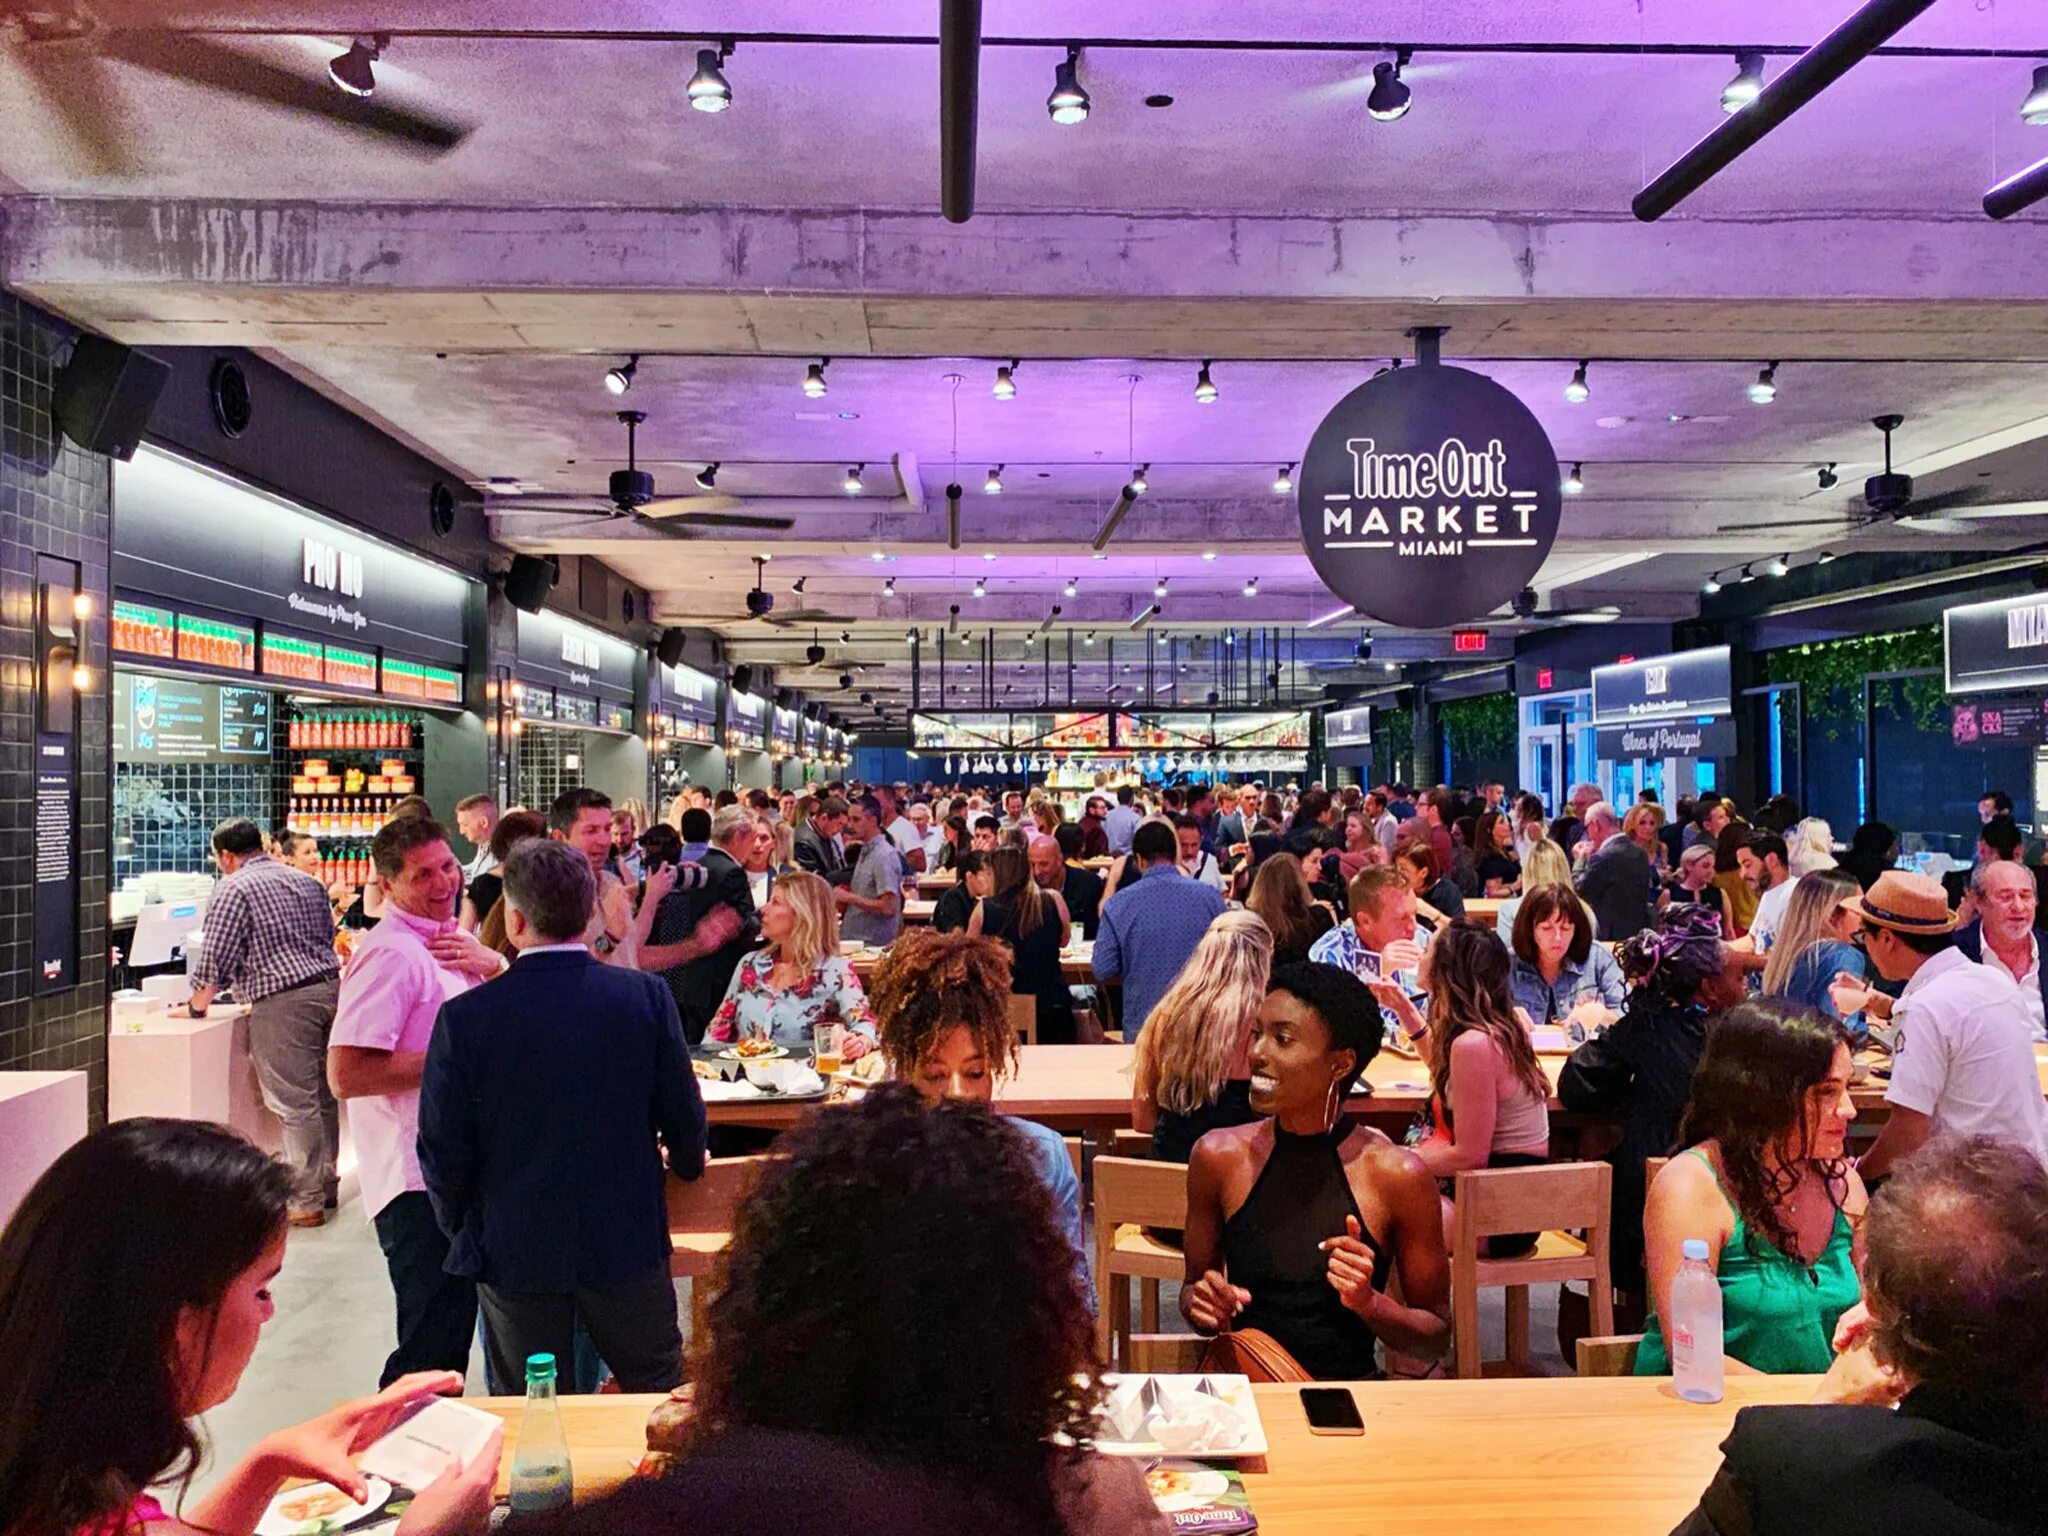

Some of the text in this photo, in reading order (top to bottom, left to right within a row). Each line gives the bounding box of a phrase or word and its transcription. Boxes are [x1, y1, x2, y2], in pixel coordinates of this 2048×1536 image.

[1323, 504, 1538, 535] MARKET
[1399, 541, 1463, 556] MIAMI
[1622, 728, 1701, 756] Wines of Portugal
